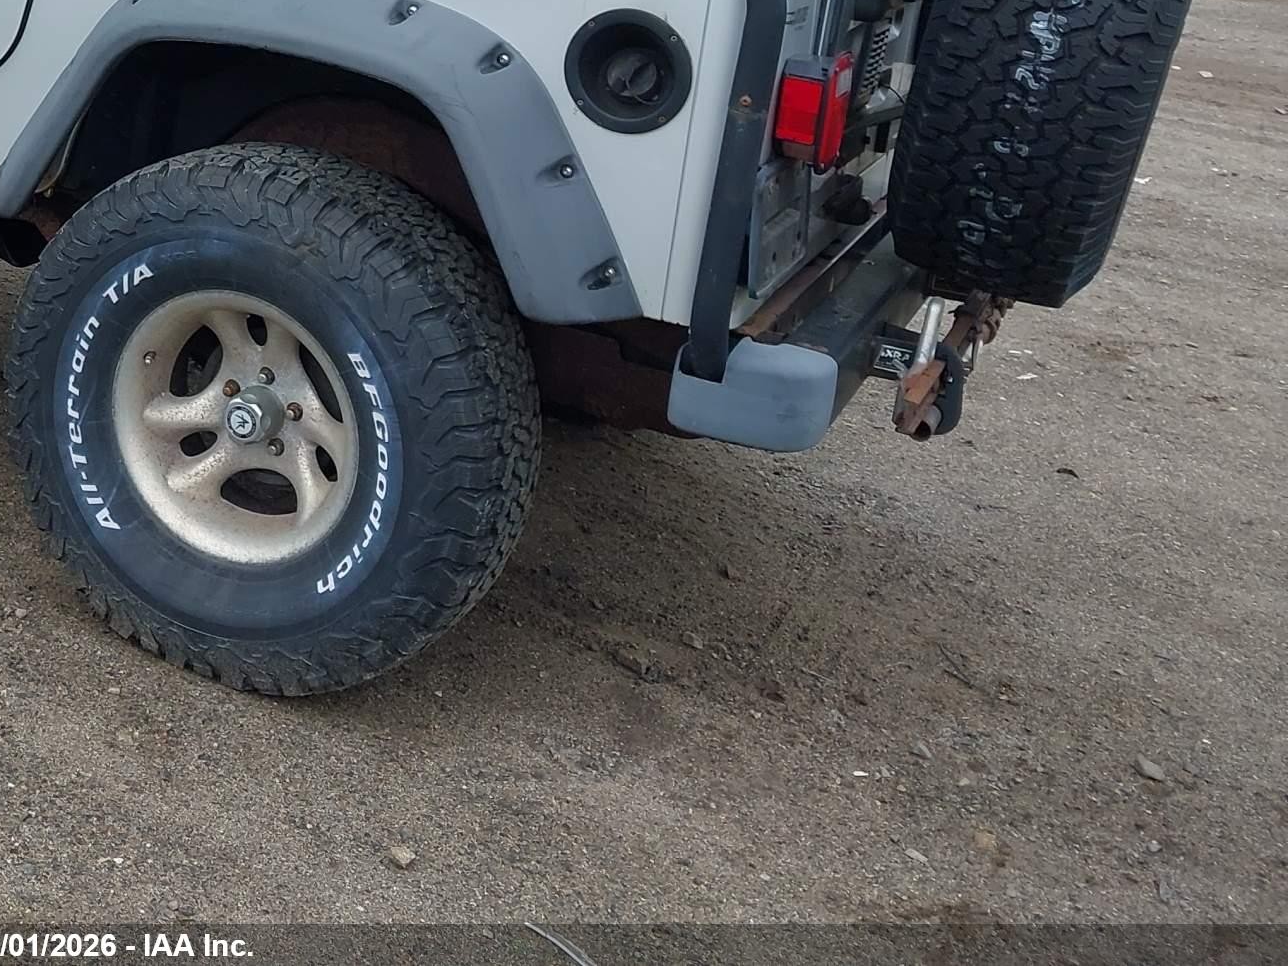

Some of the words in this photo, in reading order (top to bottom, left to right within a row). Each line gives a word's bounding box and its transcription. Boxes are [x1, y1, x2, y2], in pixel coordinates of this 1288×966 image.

[66, 314, 121, 531] All-Terrain
[101, 263, 155, 305] T/A
[315, 352, 390, 595] BFGoodrich
